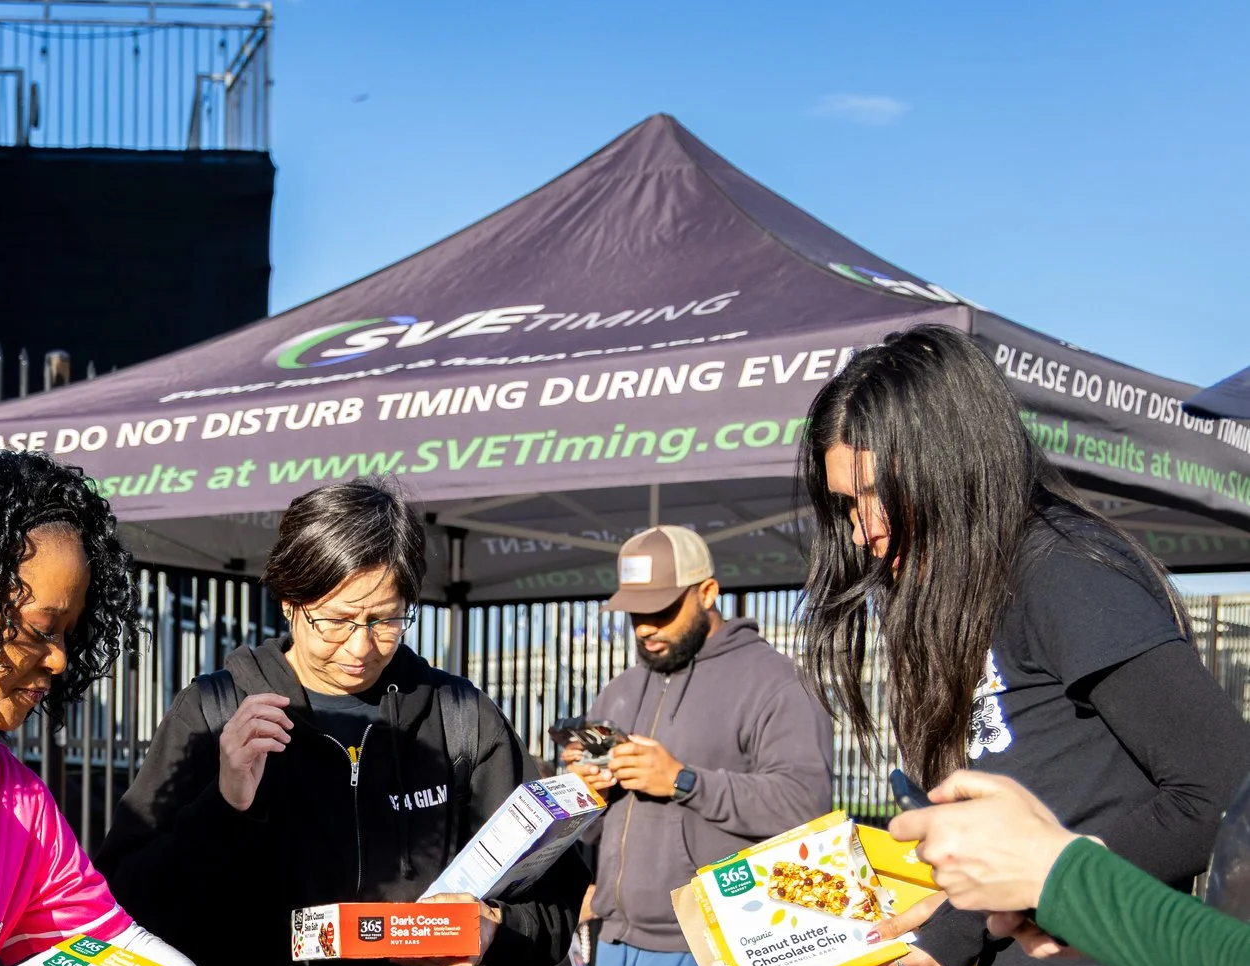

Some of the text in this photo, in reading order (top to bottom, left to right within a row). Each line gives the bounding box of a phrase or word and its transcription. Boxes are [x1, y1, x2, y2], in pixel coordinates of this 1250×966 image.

[994, 343, 1070, 393] PLEASE
[1071, 368, 1103, 403] DO
[1106, 379, 1147, 415] NOT
[55, 425, 108, 454] DO
[115, 415, 197, 448] NOT
[201, 397, 364, 440] DISTURB
[377, 380, 529, 421] TIMING
[539, 360, 726, 407] DURING
[737, 346, 855, 388] EVE
[1073, 431, 1146, 474] results
[1150, 451, 1172, 480] at
[206, 458, 256, 490] at
[719, 865, 749, 888] 365
[360, 920, 382, 934] 365
[390, 915, 450, 926] Dark Cocoa
[390, 927, 410, 937] Sea
[411, 926, 431, 937] Salt
[739, 930, 774, 947] Organic
[77, 939, 105, 952] 365
[745, 925, 829, 960] Peanut Butter
[816, 933, 848, 948] Chip
[784, 953, 817, 966] GRANOLA
